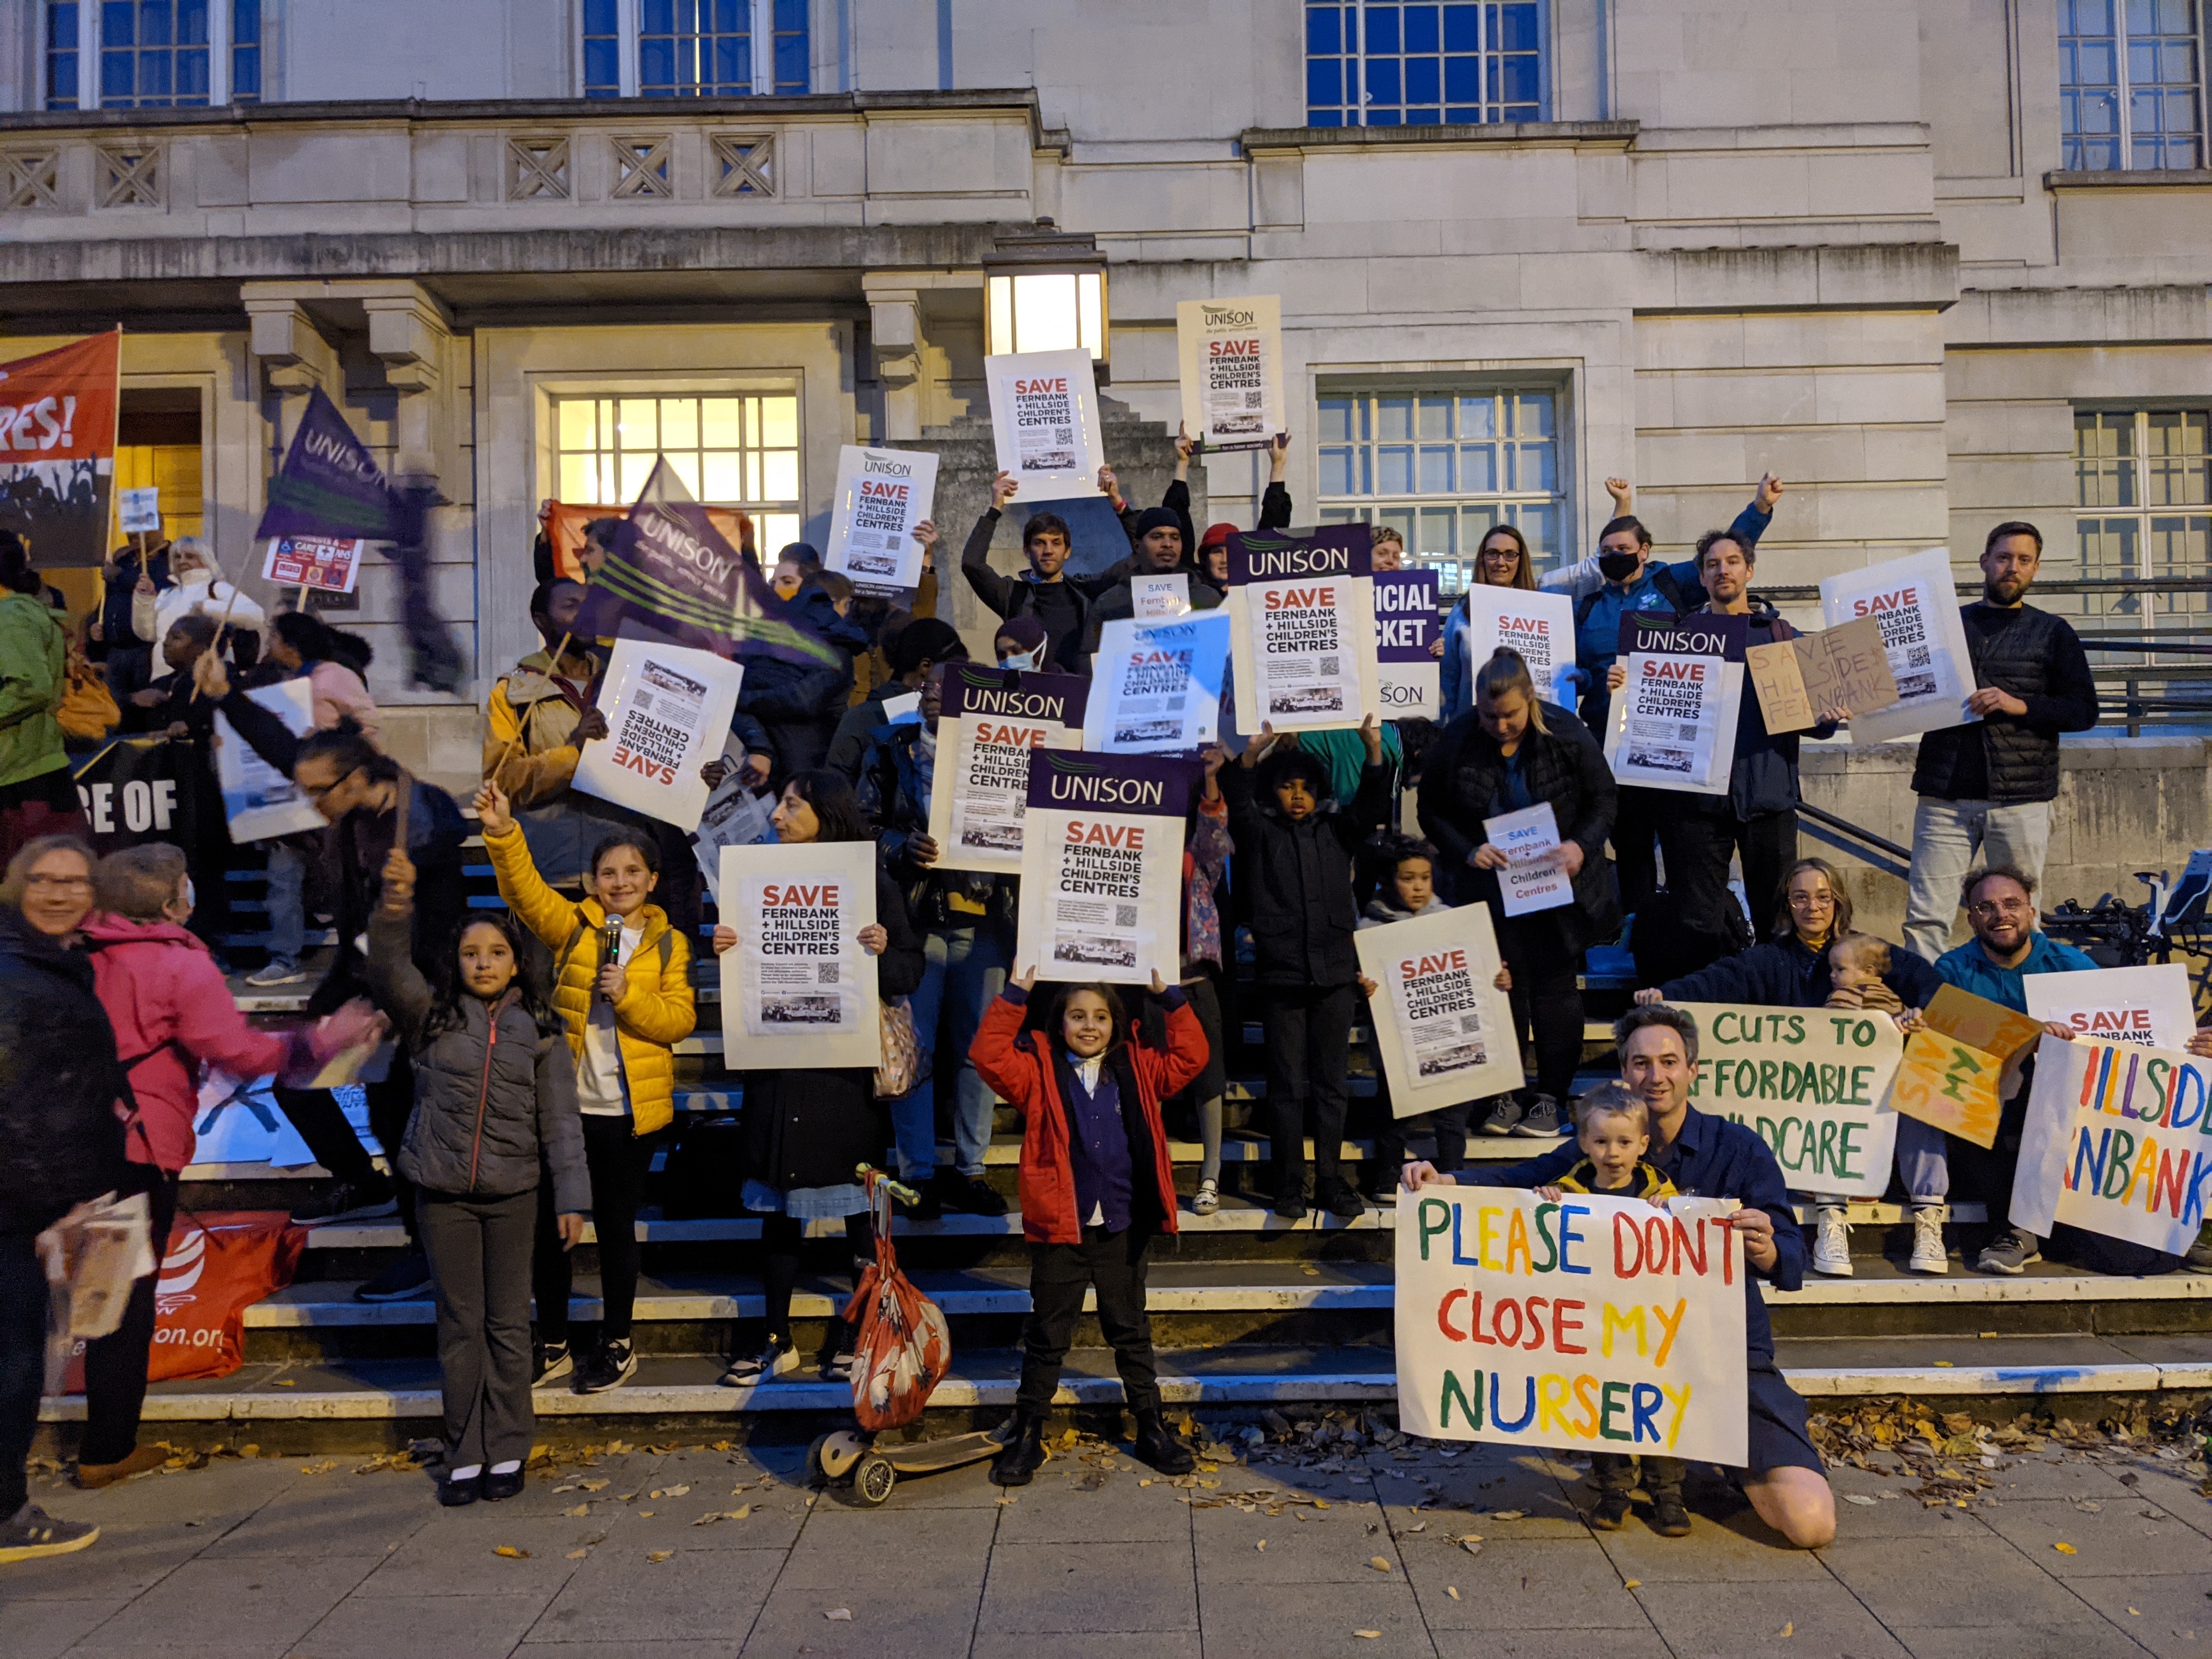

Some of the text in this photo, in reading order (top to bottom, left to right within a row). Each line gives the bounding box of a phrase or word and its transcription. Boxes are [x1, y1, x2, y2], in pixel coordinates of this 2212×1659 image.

[1205, 311, 1254, 326] UNISON
[1210, 340, 1260, 356] SAVE
[1210, 356, 1260, 364] FERNBANK
[1210, 371, 1261, 380] CHILDREN'S
[1015, 379, 1067, 394] SAVE
[1211, 380, 1261, 389] CENTRES
[1017, 394, 1068, 402] FERNBANK
[1026, 401, 1069, 409] HILLSIDE
[1017, 409, 1070, 417] CHILDREN'S
[1019, 416, 1071, 426] CENTRES
[865, 461, 911, 476] UNISON
[861, 481, 909, 500] SAVE
[860, 496, 907, 508] FERNBANK
[857, 511, 905, 523] CHILDREN'S
[866, 506, 906, 516] HILLSIDE
[856, 519, 904, 532] CENTRES
[643, 512, 734, 583] UNISON
[1249, 547, 1348, 576] UNISON
[1148, 584, 1173, 592] SAVE
[1141, 596, 1182, 605] Fernbk
[1265, 587, 1335, 610] SAVE
[1372, 584, 1436, 612] ICIAL
[1854, 588, 1918, 617] SAVE
[1266, 608, 1336, 620] FERNBANK
[1876, 605, 1920, 622] NBANK
[1278, 618, 1337, 630] HILLSIDE
[1498, 616, 1549, 635] SAVE
[1882, 622, 1923, 639] DREN'S
[1266, 629, 1338, 641] CHILDREN'S
[1499, 630, 1550, 642] FERNBANK
[1637, 630, 1726, 653] UNISON
[1267, 639, 1338, 653] CENTRES
[1508, 639, 1550, 650] HILLSIDE
[1752, 631, 1846, 670] SAVE
[1130, 649, 1194, 667] SAVE
[1643, 660, 1706, 681] SAVE
[1760, 653, 1870, 698] HILLSIDE
[1123, 685, 1188, 696] CENTRES
[1641, 678, 1703, 691] FERNBANK
[1650, 687, 1703, 699] HILLSIDE
[964, 688, 1064, 718] UNISON
[1638, 696, 1701, 708] CHILDREN'S
[1637, 705, 1700, 719] CENTRES
[629, 710, 690, 743] CENTRES
[620, 728, 674, 757] HILLSIDE
[624, 720, 686, 751] CHILDREN'S
[975, 723, 1047, 748] SAVE
[619, 737, 680, 770] FERNBANK
[612, 746, 676, 786] SAVE
[1052, 775, 1163, 805] UNISON
[123, 779, 178, 833] OF
[1065, 821, 1144, 849] SAVE
[1509, 826, 1538, 840] SAVE
[1064, 844, 1142, 862] FERNBANK
[1076, 857, 1142, 873] HILLSIDE
[1062, 868, 1141, 884] CHILDREN'S
[1510, 868, 1556, 885] Children
[763, 885, 839, 906] SAVE
[1060, 879, 1139, 898] CENTRES
[1516, 883, 1558, 899] Centres
[762, 909, 839, 918] FERNBANK
[775, 920, 840, 930] HILLSIDE
[761, 932, 840, 941] CHILDREN'S
[762, 943, 840, 955] CENTRES
[1400, 949, 1467, 979] SAVE
[1403, 969, 1470, 990] FERNBANK
[1416, 978, 1471, 997] HILLSIDE
[1407, 988, 1474, 1009] CHILDREN'S
[1409, 997, 1476, 1020] CENTRES
[2070, 1009, 2151, 1032] SAVE
[1712, 1012, 1807, 1045] CUTS
[1830, 1018, 1877, 1047] TO
[1687, 1058, 1875, 1106] FFORDABLE
[1940, 1047, 1983, 1103] MY
[2064, 1126, 2212, 1229] NBANK
[1418, 1198, 1591, 1277] PLEASE
[1438, 1289, 1687, 1367] CLOSE MY
[1441, 1369, 1691, 1450] NURSERY
